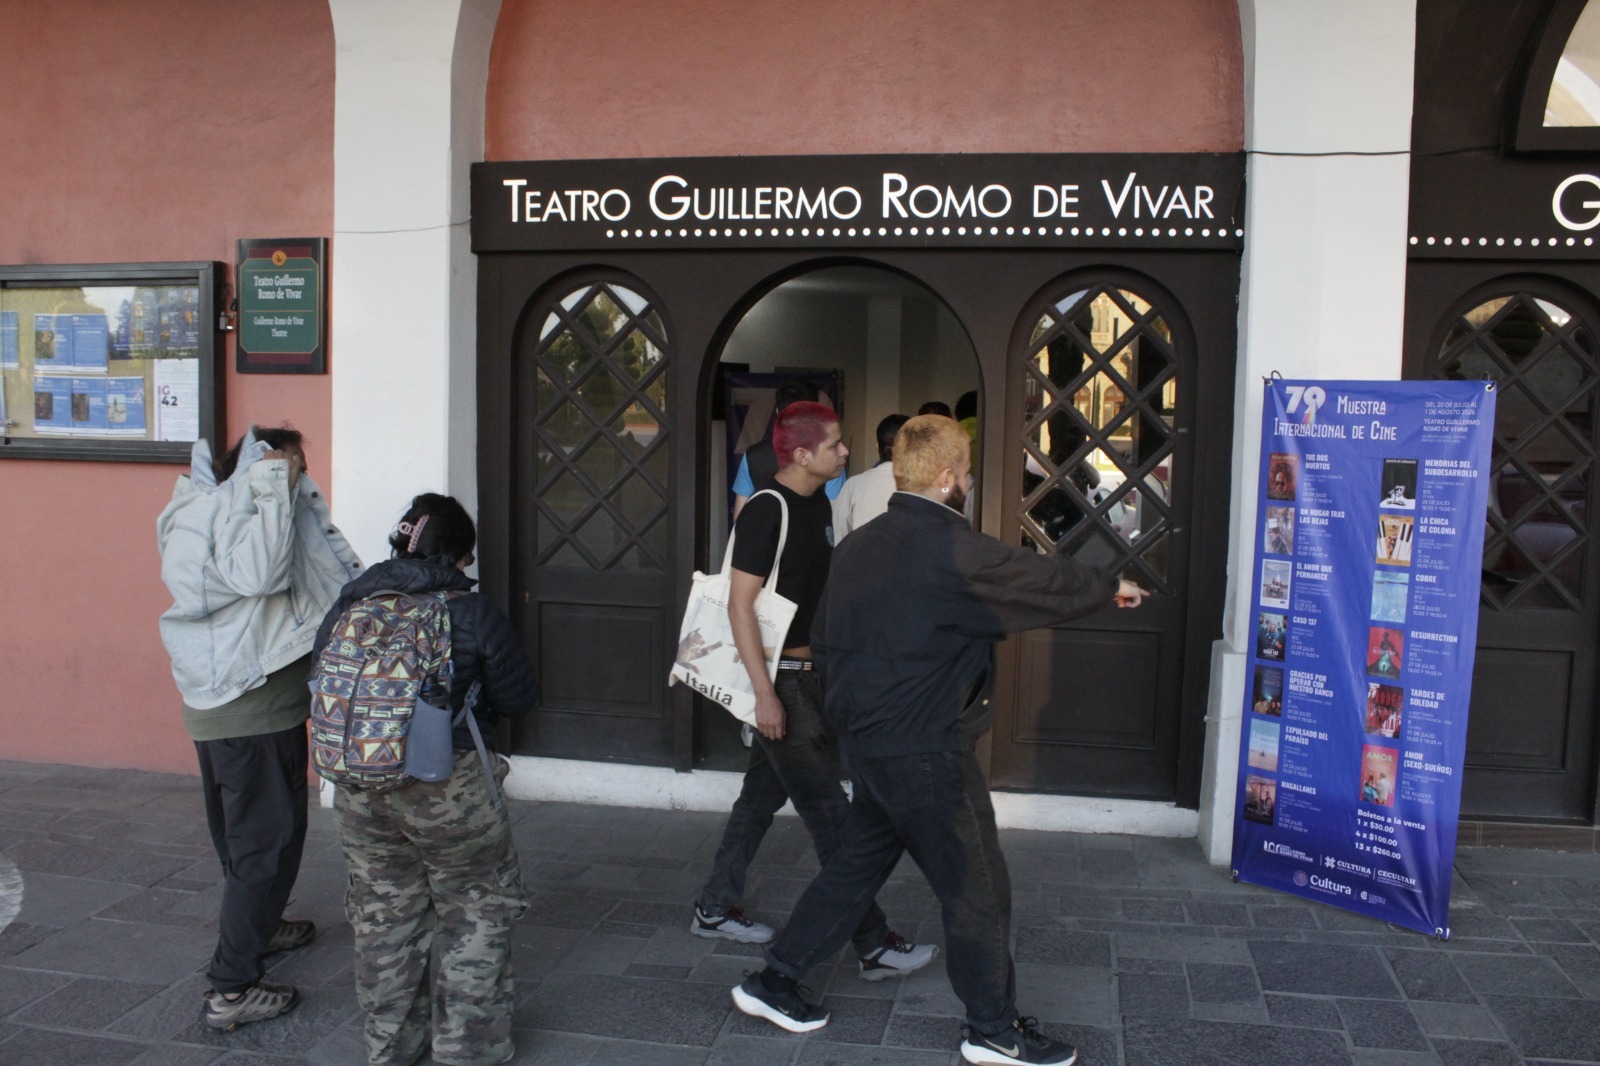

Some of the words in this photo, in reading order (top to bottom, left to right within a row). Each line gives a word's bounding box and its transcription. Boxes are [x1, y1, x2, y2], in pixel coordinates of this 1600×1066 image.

[503, 179, 631, 223] TEATRO
[649, 175, 862, 221] GUILLERMO
[882, 172, 1013, 219] ROMO
[1033, 184, 1079, 218] DE
[1101, 172, 1215, 219] VIVAR
[254, 276, 274, 286] Teatro
[274, 274, 304, 286] Guillermo
[258, 289, 275, 299] Romo
[276, 288, 284, 299] de
[285, 288, 302, 299] Vivar
[161, 396, 178, 406] 42
[1285, 386, 1326, 424] 79
[1337, 396, 1386, 416] MUESTRA
[1274, 418, 1347, 439] INTERNACIONAL
[1352, 425, 1365, 440] DE
[1370, 421, 1398, 440] CINE
[1305, 462, 1330, 470] MUERTOS
[1425, 459, 1458, 468] MEMORIAS
[1424, 468, 1478, 478] SUBDESARROLLO
[1430, 518, 1449, 526] CHICA
[1429, 526, 1456, 535] COLONIA
[1304, 564, 1319, 572] AMOR
[1320, 565, 1333, 573] QUE
[1296, 571, 1328, 581] PERMANECE
[1415, 574, 1437, 583] COBRE
[1293, 616, 1307, 624] CASO
[1308, 618, 1317, 626] 137
[1411, 631, 1458, 643] RESURRECTION
[1290, 670, 1314, 680] GRACIAS
[1315, 672, 1327, 682] POR
[686, 672, 733, 706] Italia
[1289, 677, 1311, 687] OPERAR
[1312, 679, 1324, 689] CON
[1289, 684, 1314, 695] NUESTRO
[1315, 687, 1334, 698] BANCO
[1411, 688, 1435, 700] TARDES
[1436, 692, 1445, 700] DE
[1410, 698, 1439, 709] SOLEDAD
[1286, 726, 1317, 738] EXPULSADO
[1318, 732, 1328, 740] DEL
[1285, 734, 1309, 746] PARAÍSO
[1366, 752, 1393, 762] AMOR
[1404, 750, 1424, 760] AMOR
[1404, 760, 1452, 776] (SEXO-SUEÑOS)
[1281, 781, 1317, 795] MAGALLANES
[1358, 809, 1385, 821] Boletos
[1403, 820, 1425, 830] venta
[1370, 821, 1394, 833] $30.00
[1369, 833, 1398, 846] $100.00
[1372, 846, 1401, 860] $260.00
[1337, 860, 1371, 874] CULTURA
[1378, 870, 1416, 885] CECULTAH
[1310, 874, 1351, 895] Cultura
